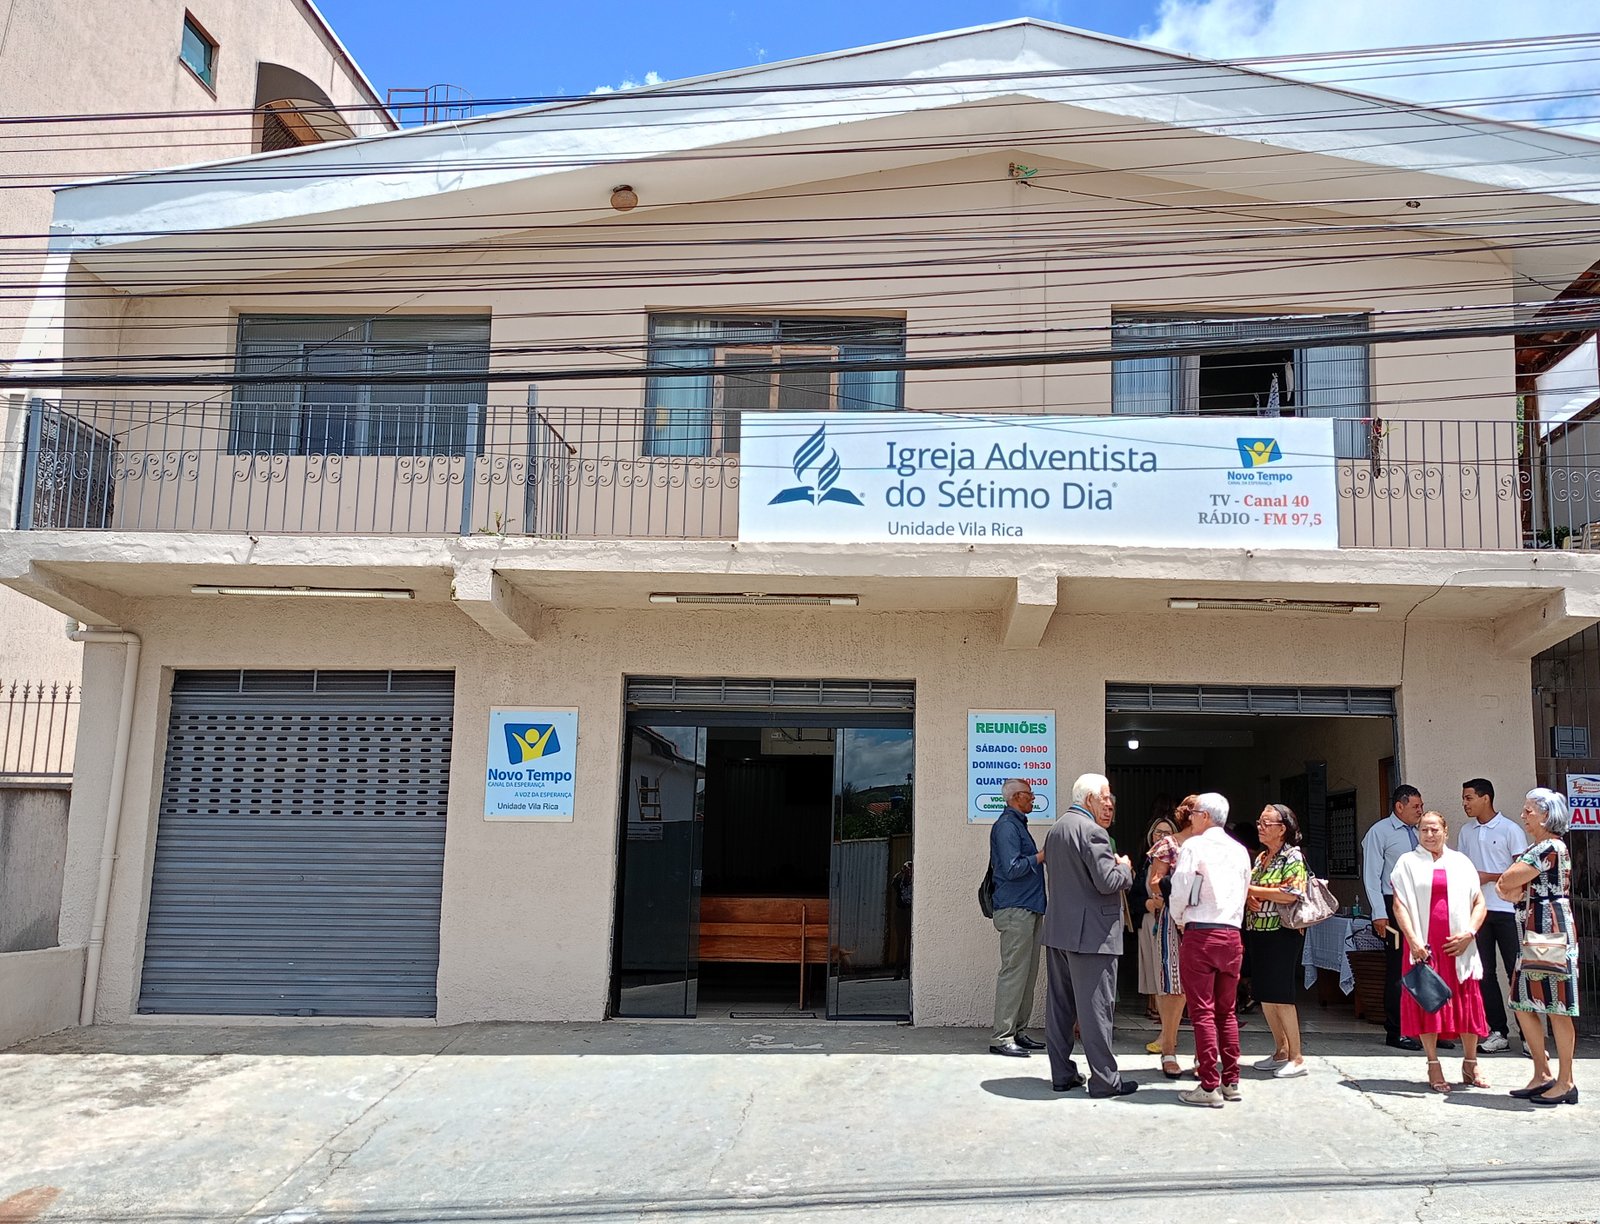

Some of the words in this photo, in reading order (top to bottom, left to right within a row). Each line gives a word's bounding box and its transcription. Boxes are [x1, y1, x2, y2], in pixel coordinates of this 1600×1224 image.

[886, 441, 975, 477] Igreja
[985, 442, 1158, 473] Adventista
[1227, 471, 1255, 481] Novo
[1256, 471, 1293, 483] Tempo
[885, 479, 926, 507] do
[938, 479, 1050, 509] Sétimo
[1210, 494, 1231, 506] TV
[1243, 494, 1288, 507] Canal
[1291, 495, 1309, 507] 40
[1197, 509, 1250, 525] RÁDIO
[1263, 512, 1287, 525] FM
[1291, 513, 1322, 527] 97,5
[888, 521, 955, 536] Unidade
[958, 522, 987, 536] Vila
[991, 522, 1023, 537] Rica
[975, 721, 1047, 734] REUNIÕES
[975, 743, 1018, 753] SÁBADO:
[1020, 745, 1048, 753] 09h00
[972, 761, 1021, 769] DOMINGO:
[488, 768, 523, 781] Novo
[526, 769, 572, 784] Tempo
[975, 777, 1008, 786] QUART
[497, 802, 526, 810] Unidade
[1571, 797, 1599, 807] 3721
